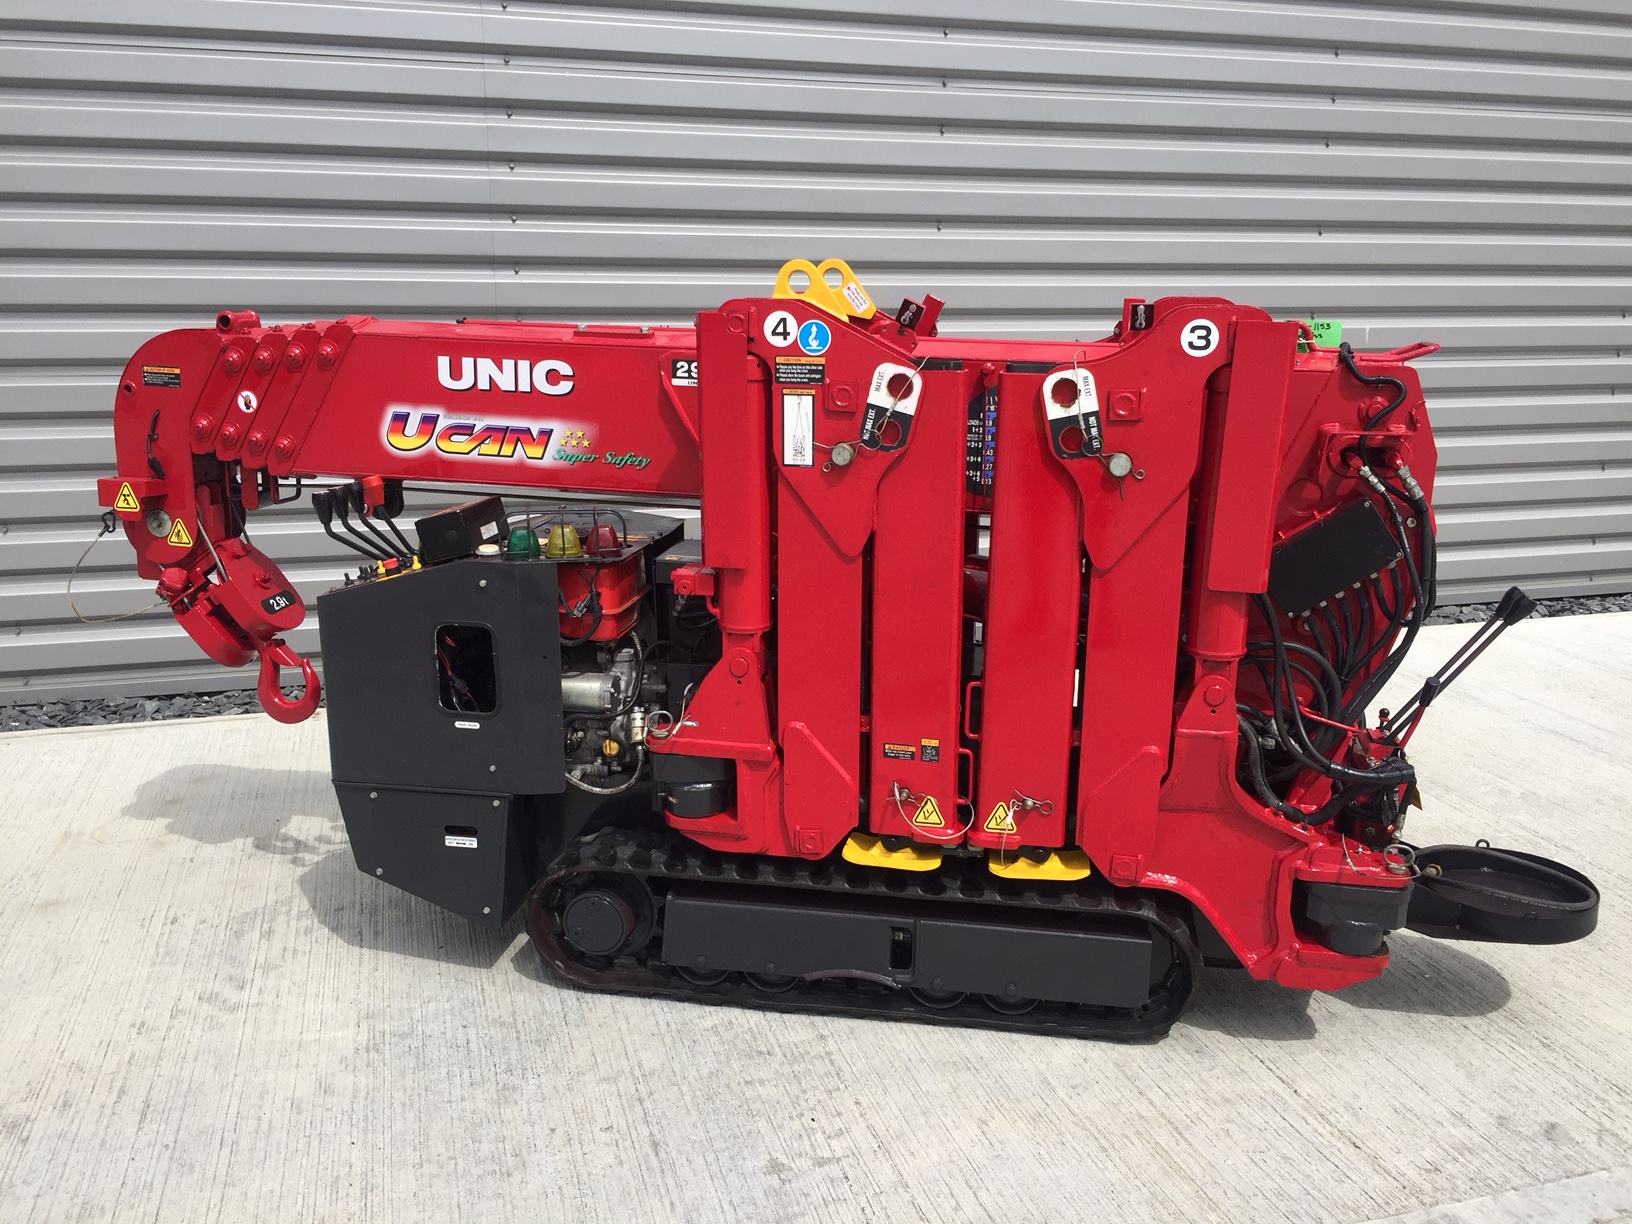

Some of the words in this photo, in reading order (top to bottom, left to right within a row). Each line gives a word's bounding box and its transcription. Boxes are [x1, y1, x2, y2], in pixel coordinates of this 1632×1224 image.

[771, 317, 790, 341] 4
[1188, 325, 1212, 350] 3
[437, 355, 574, 396] UNIC
[1088, 416, 1097, 427] NOT
[386, 411, 554, 460] UCAN
[552, 448, 599, 467] Super
[602, 451, 651, 470] Safety
